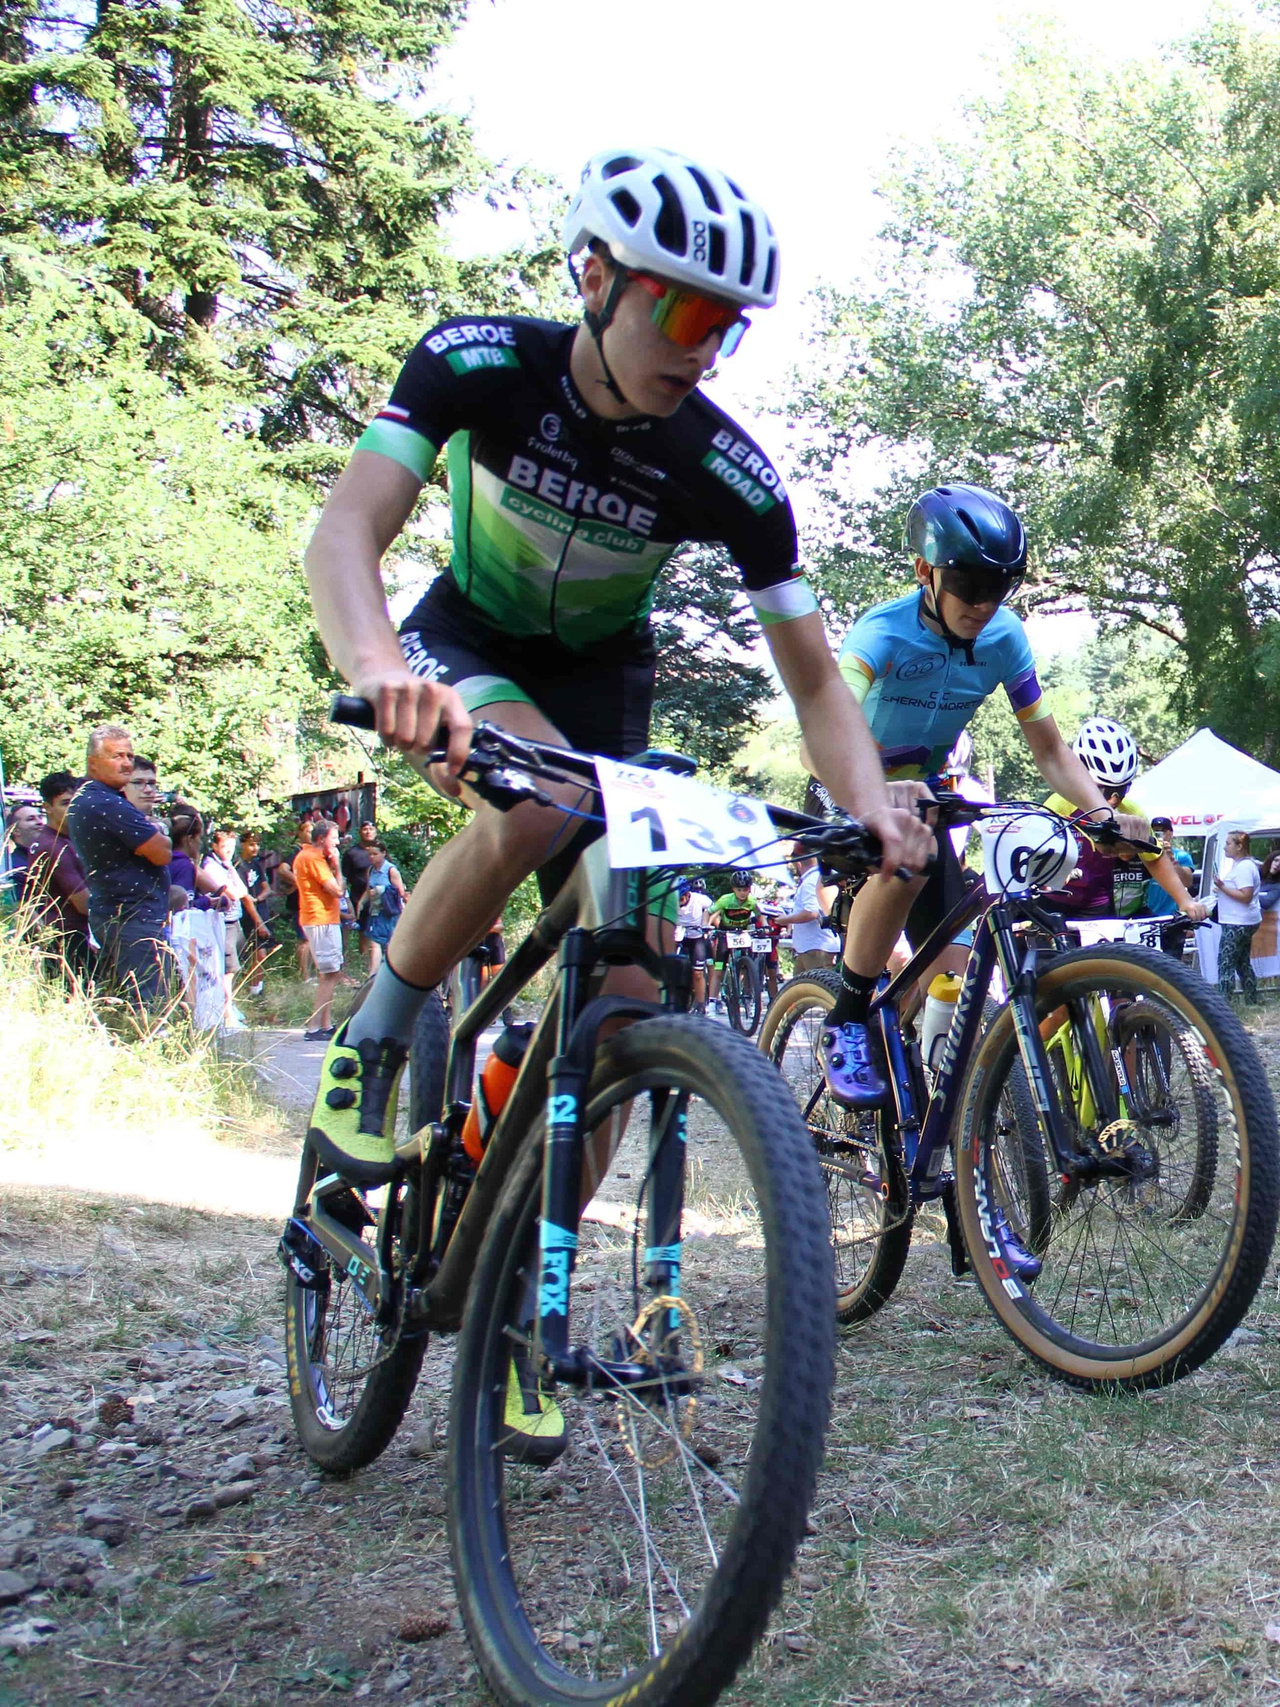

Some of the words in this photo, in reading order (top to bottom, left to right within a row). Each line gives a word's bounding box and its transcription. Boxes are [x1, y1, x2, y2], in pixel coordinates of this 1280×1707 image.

[693, 221, 707, 262] POC
[425, 324, 517, 354] BEROE
[460, 346, 506, 368] MTB
[508, 455, 658, 536] BEROE
[709, 456, 766, 506] ROAD
[593, 529, 639, 551] club
[1010, 845, 1055, 884] 61
[541, 1251, 569, 1317] FOX
